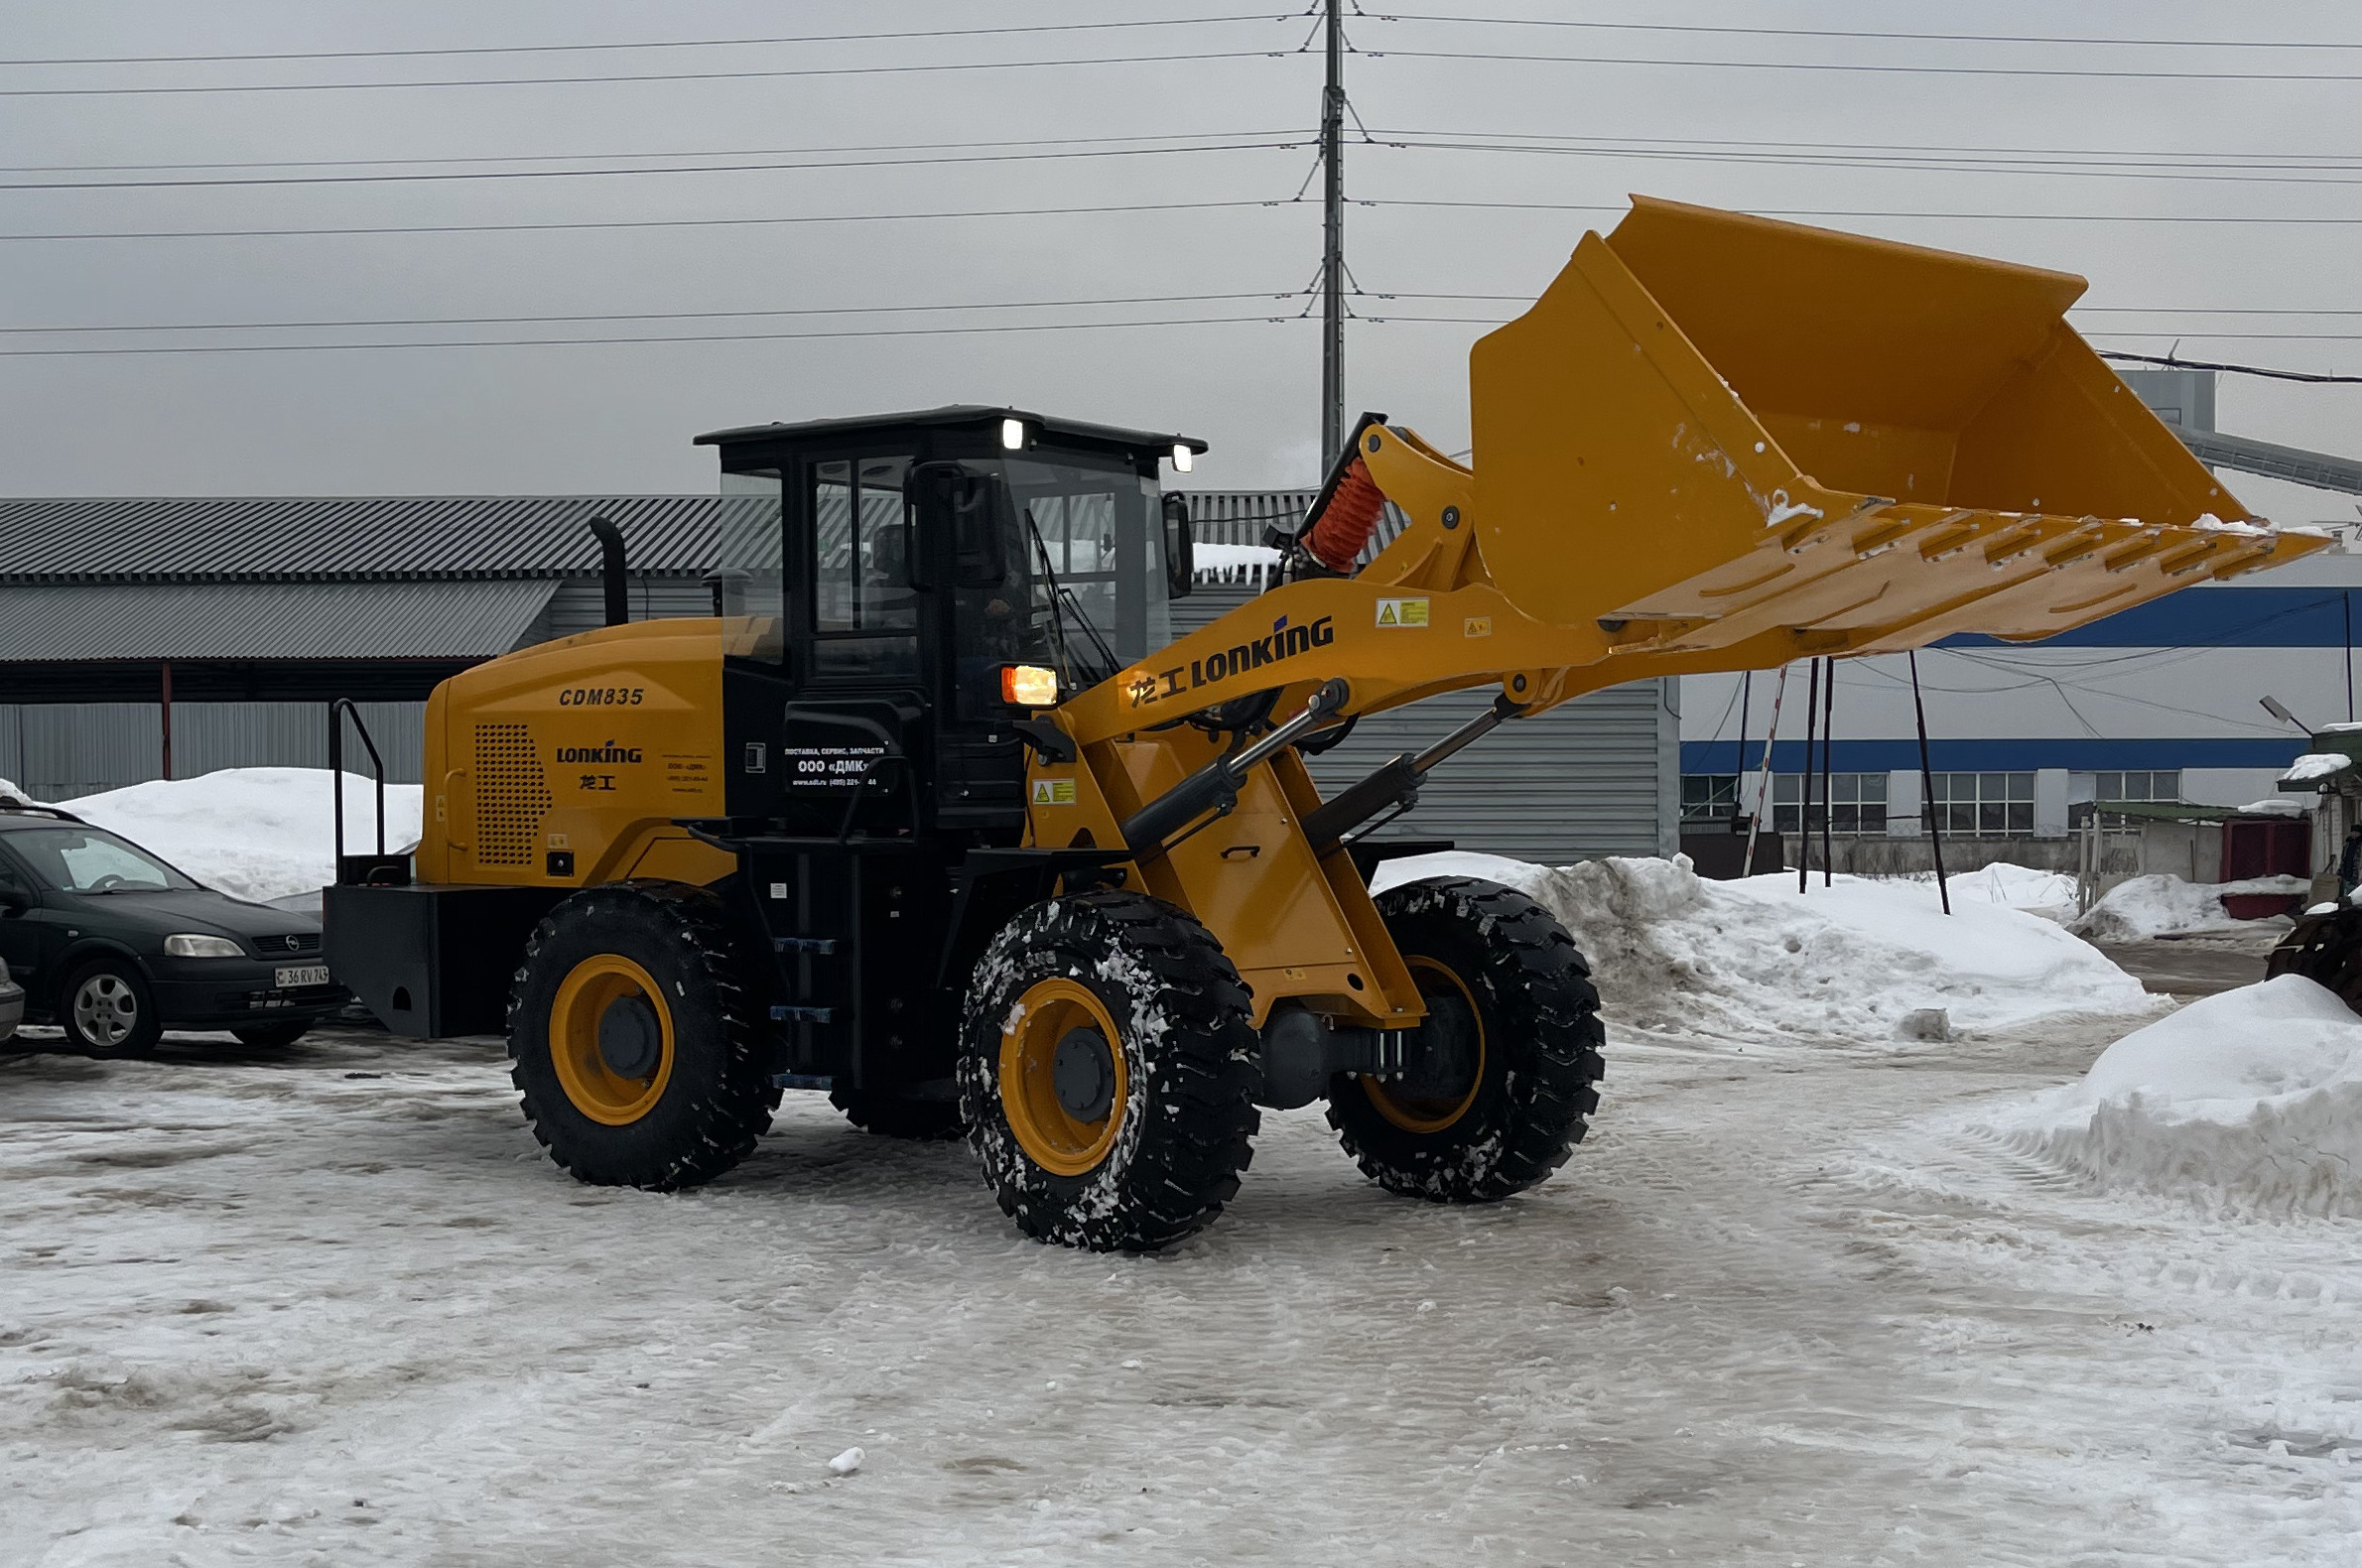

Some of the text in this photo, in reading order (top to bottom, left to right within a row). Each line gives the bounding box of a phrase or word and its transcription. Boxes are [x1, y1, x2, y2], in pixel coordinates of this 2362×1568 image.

[559, 688, 645, 706] CDM835
[798, 760, 825, 772] ООО
[288, 970, 299, 983] 36
[301, 969, 312, 982] RV
